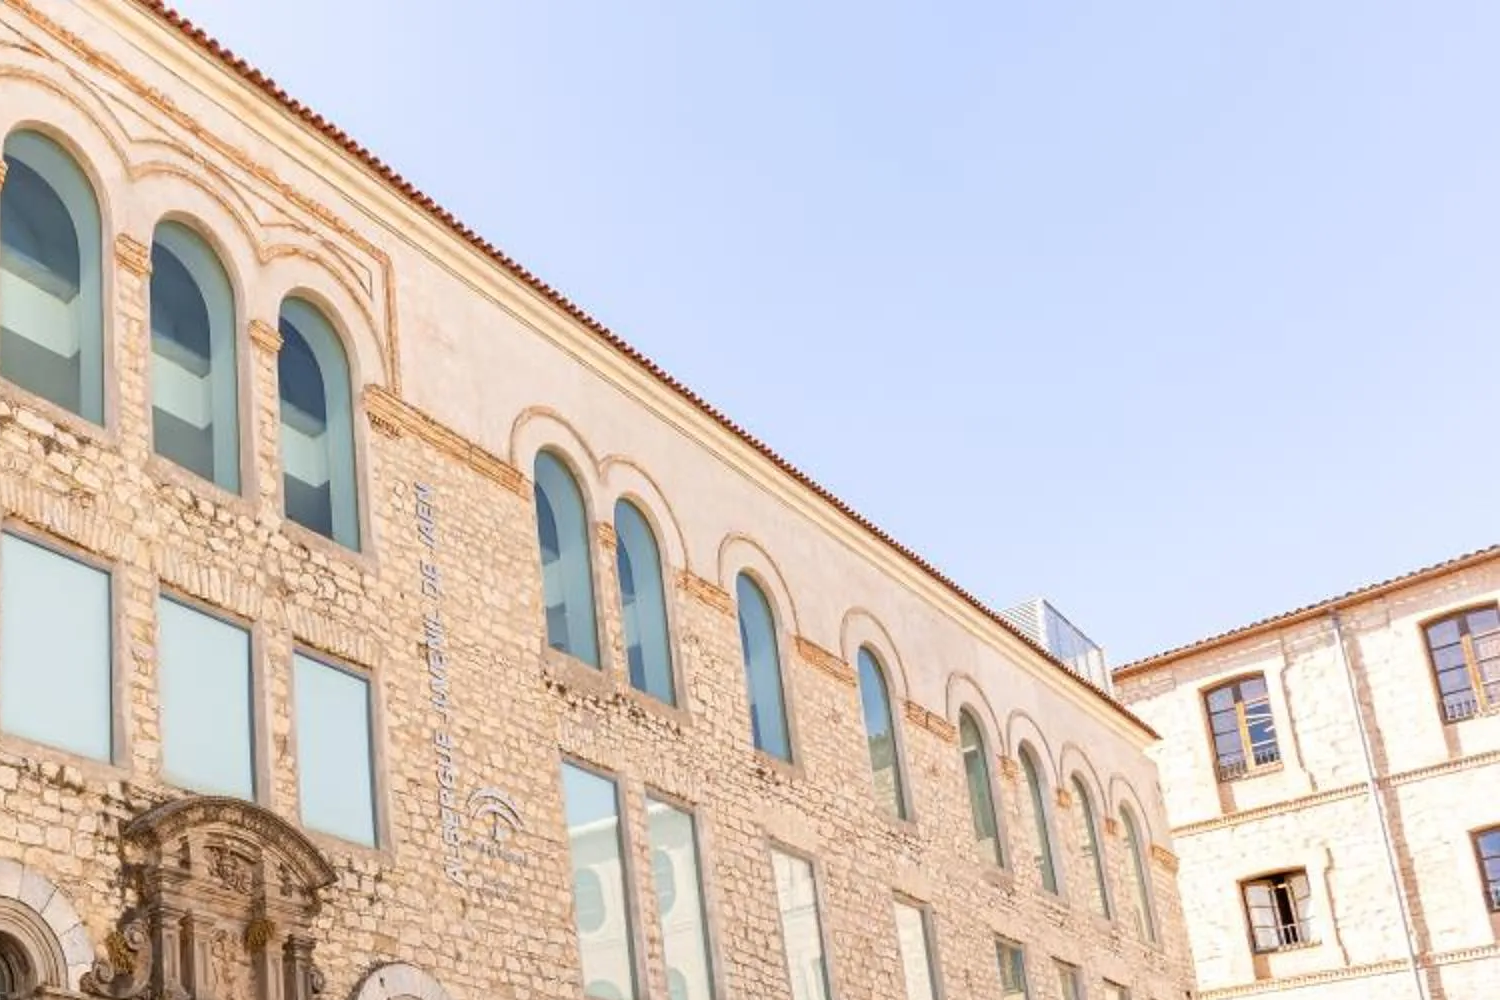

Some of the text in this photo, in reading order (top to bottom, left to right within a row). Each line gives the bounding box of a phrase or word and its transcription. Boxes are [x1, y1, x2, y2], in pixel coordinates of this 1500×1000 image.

[420, 559, 442, 600] DE
[422, 606, 450, 725] JUVENIL
[433, 729, 468, 890] ALBERGUE
